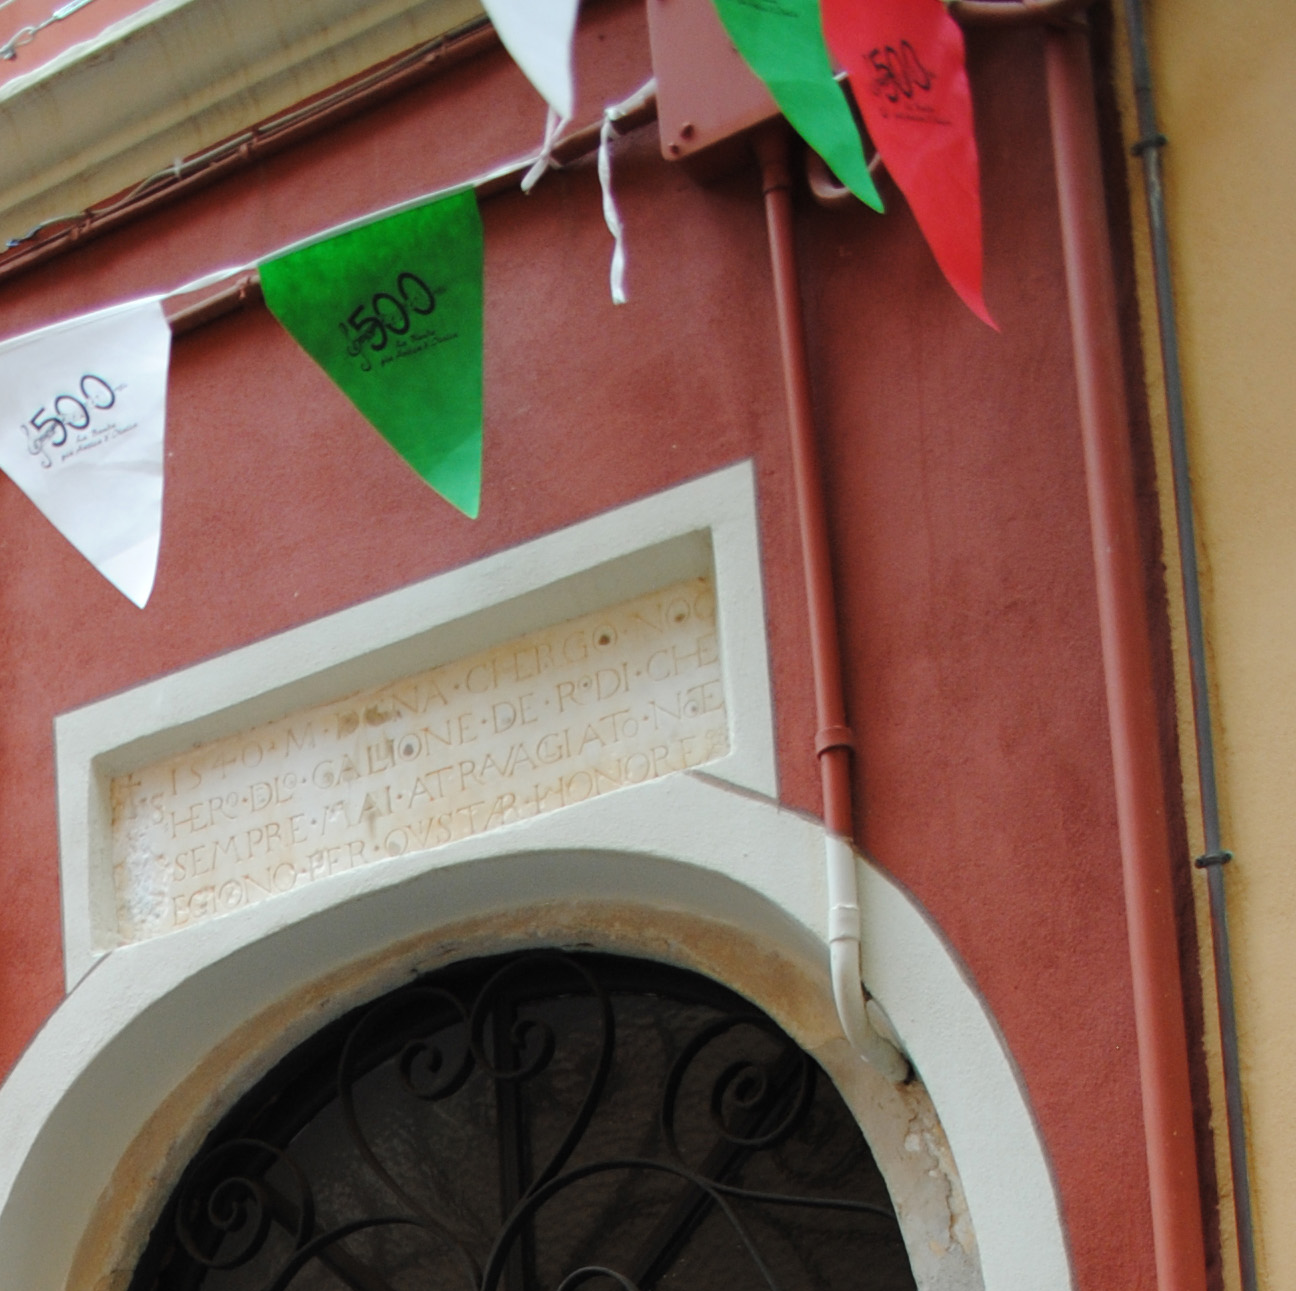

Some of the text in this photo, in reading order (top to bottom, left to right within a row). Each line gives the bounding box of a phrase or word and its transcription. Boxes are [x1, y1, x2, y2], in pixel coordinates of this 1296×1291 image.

[869, 39, 932, 103] 500
[347, 272, 436, 351] 500
[29, 375, 115, 447] 500
[171, 811, 307, 884] SEMPRE
